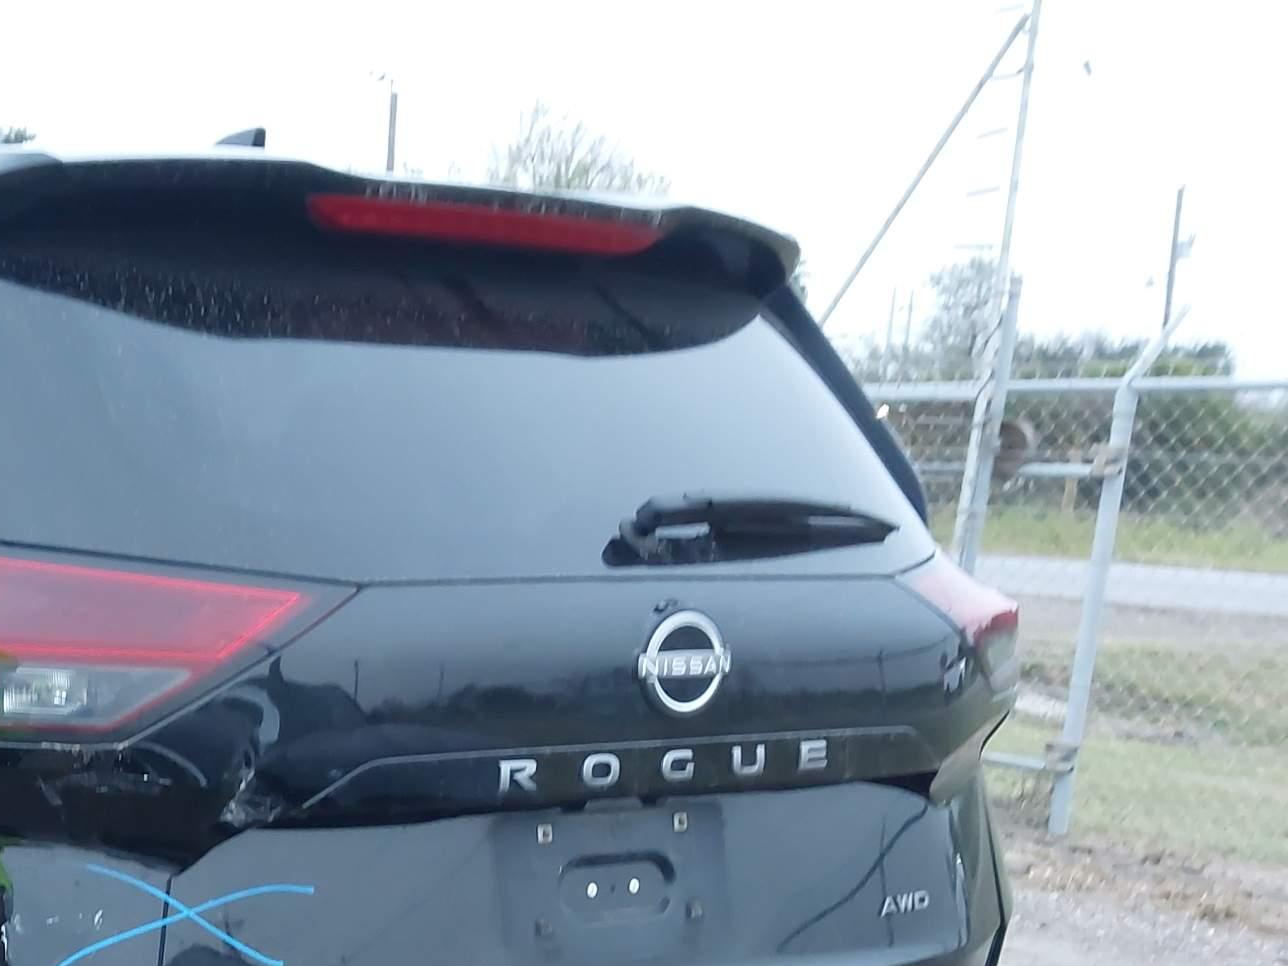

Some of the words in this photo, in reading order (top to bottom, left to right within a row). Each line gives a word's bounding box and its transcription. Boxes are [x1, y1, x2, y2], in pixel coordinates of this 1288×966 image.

[641, 653, 731, 677] NISSAN
[499, 739, 829, 792] ROGUE
[880, 890, 930, 918] AWD
